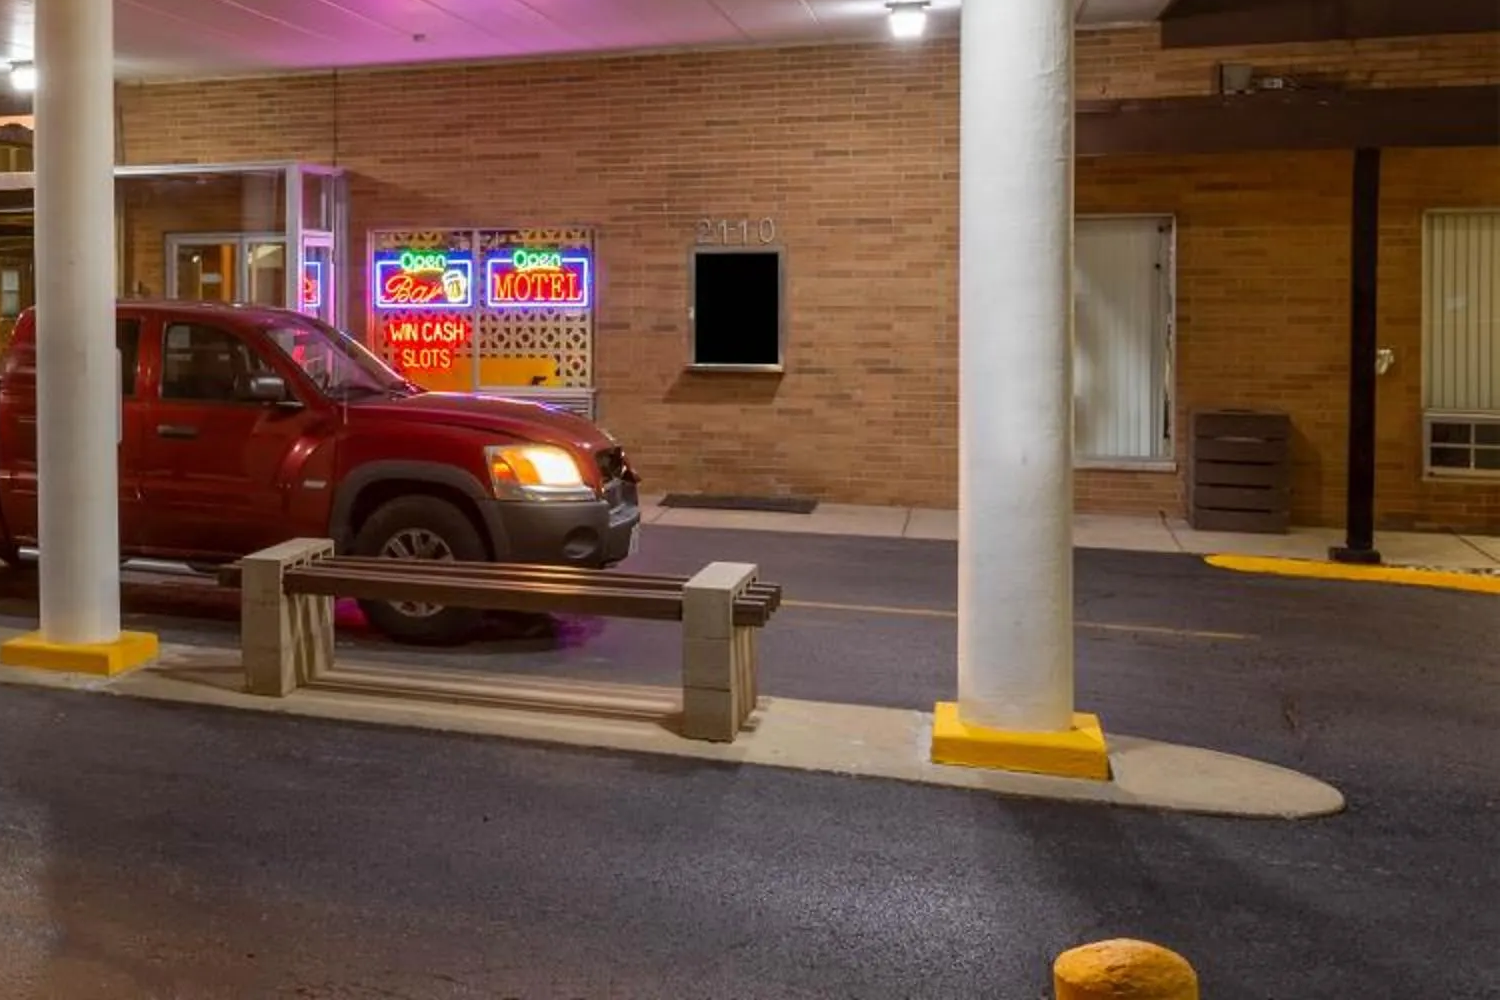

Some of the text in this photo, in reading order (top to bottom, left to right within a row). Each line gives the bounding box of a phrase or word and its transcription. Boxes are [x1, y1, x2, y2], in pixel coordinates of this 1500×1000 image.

[401, 252, 446, 272] Open
[513, 250, 561, 270] Open
[380, 275, 443, 303] Bar
[493, 273, 583, 301] MOTEL
[389, 321, 465, 342] WIN CASH
[402, 347, 451, 369] SLOTS
